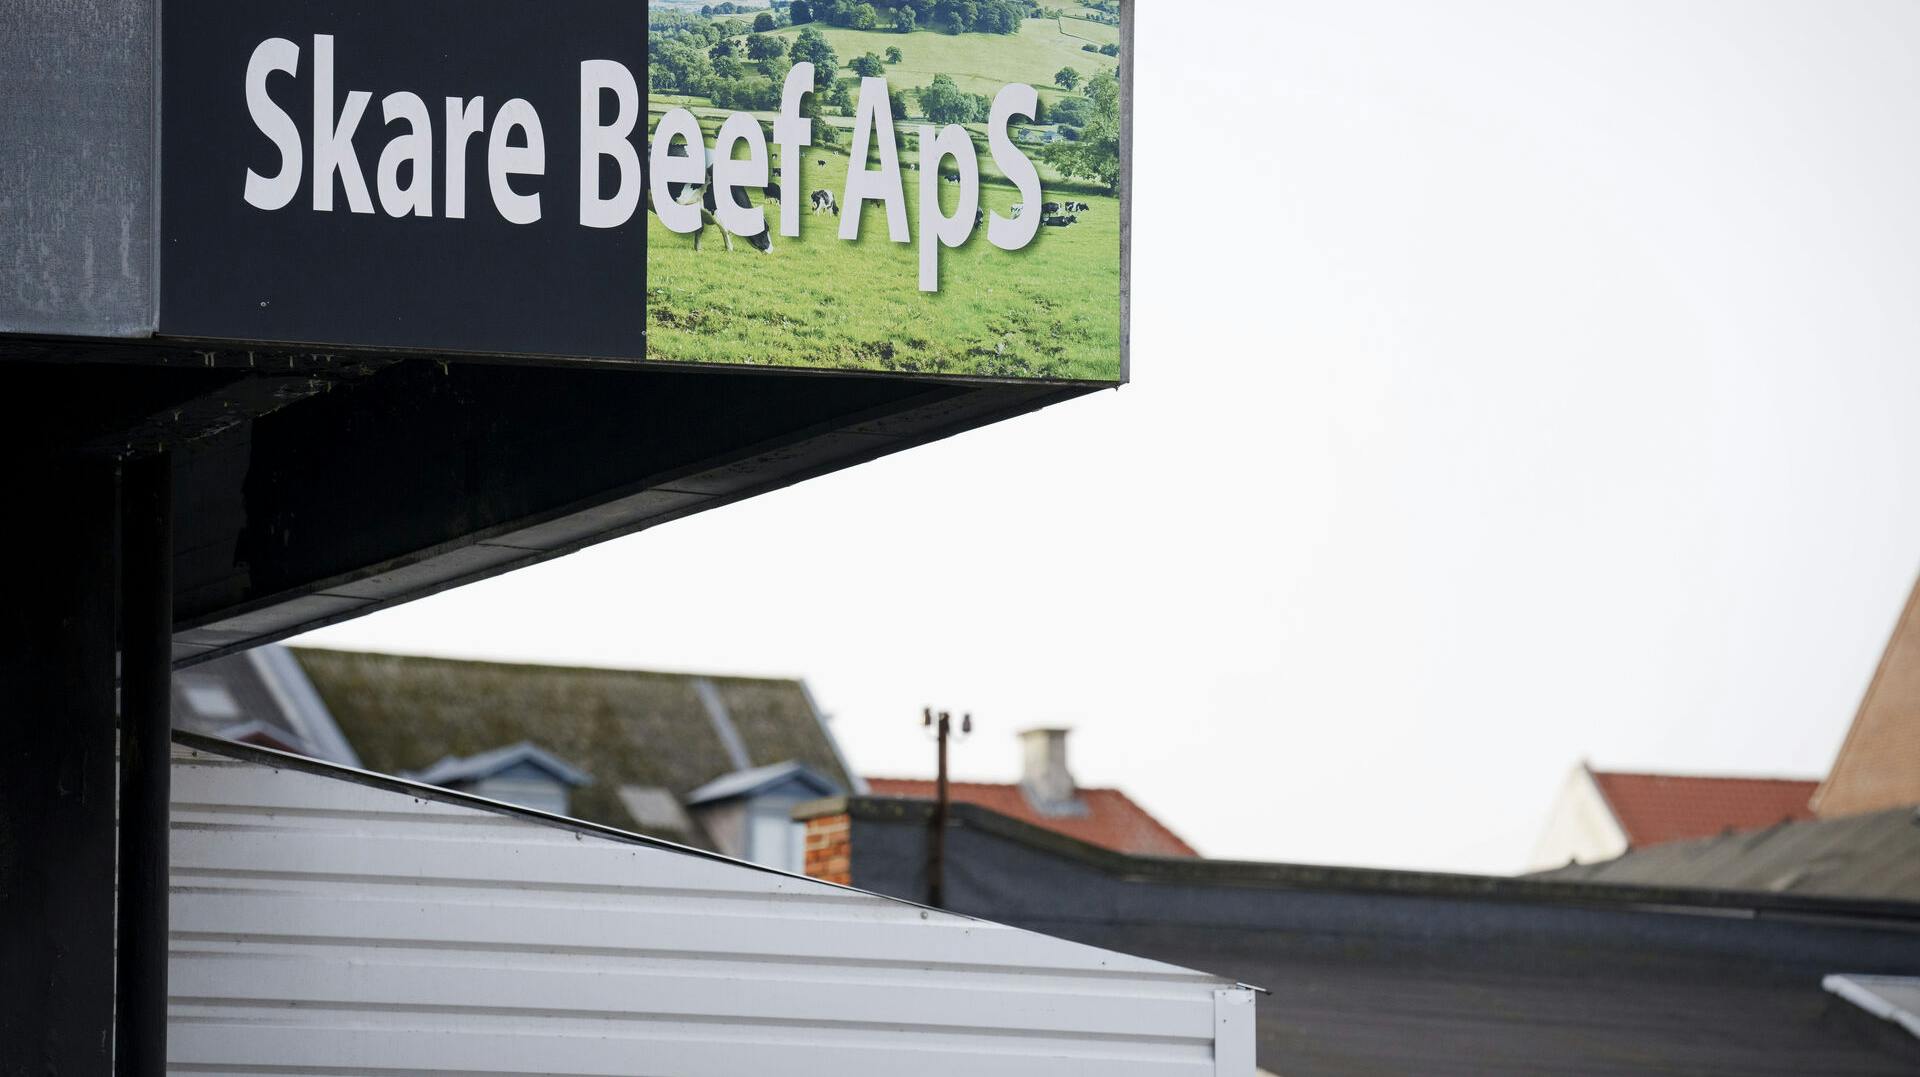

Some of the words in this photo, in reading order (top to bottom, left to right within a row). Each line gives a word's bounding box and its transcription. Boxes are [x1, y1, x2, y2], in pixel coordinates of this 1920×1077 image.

[243, 33, 546, 225] Skare
[579, 59, 815, 238] Beef
[838, 76, 1042, 292] ApS
